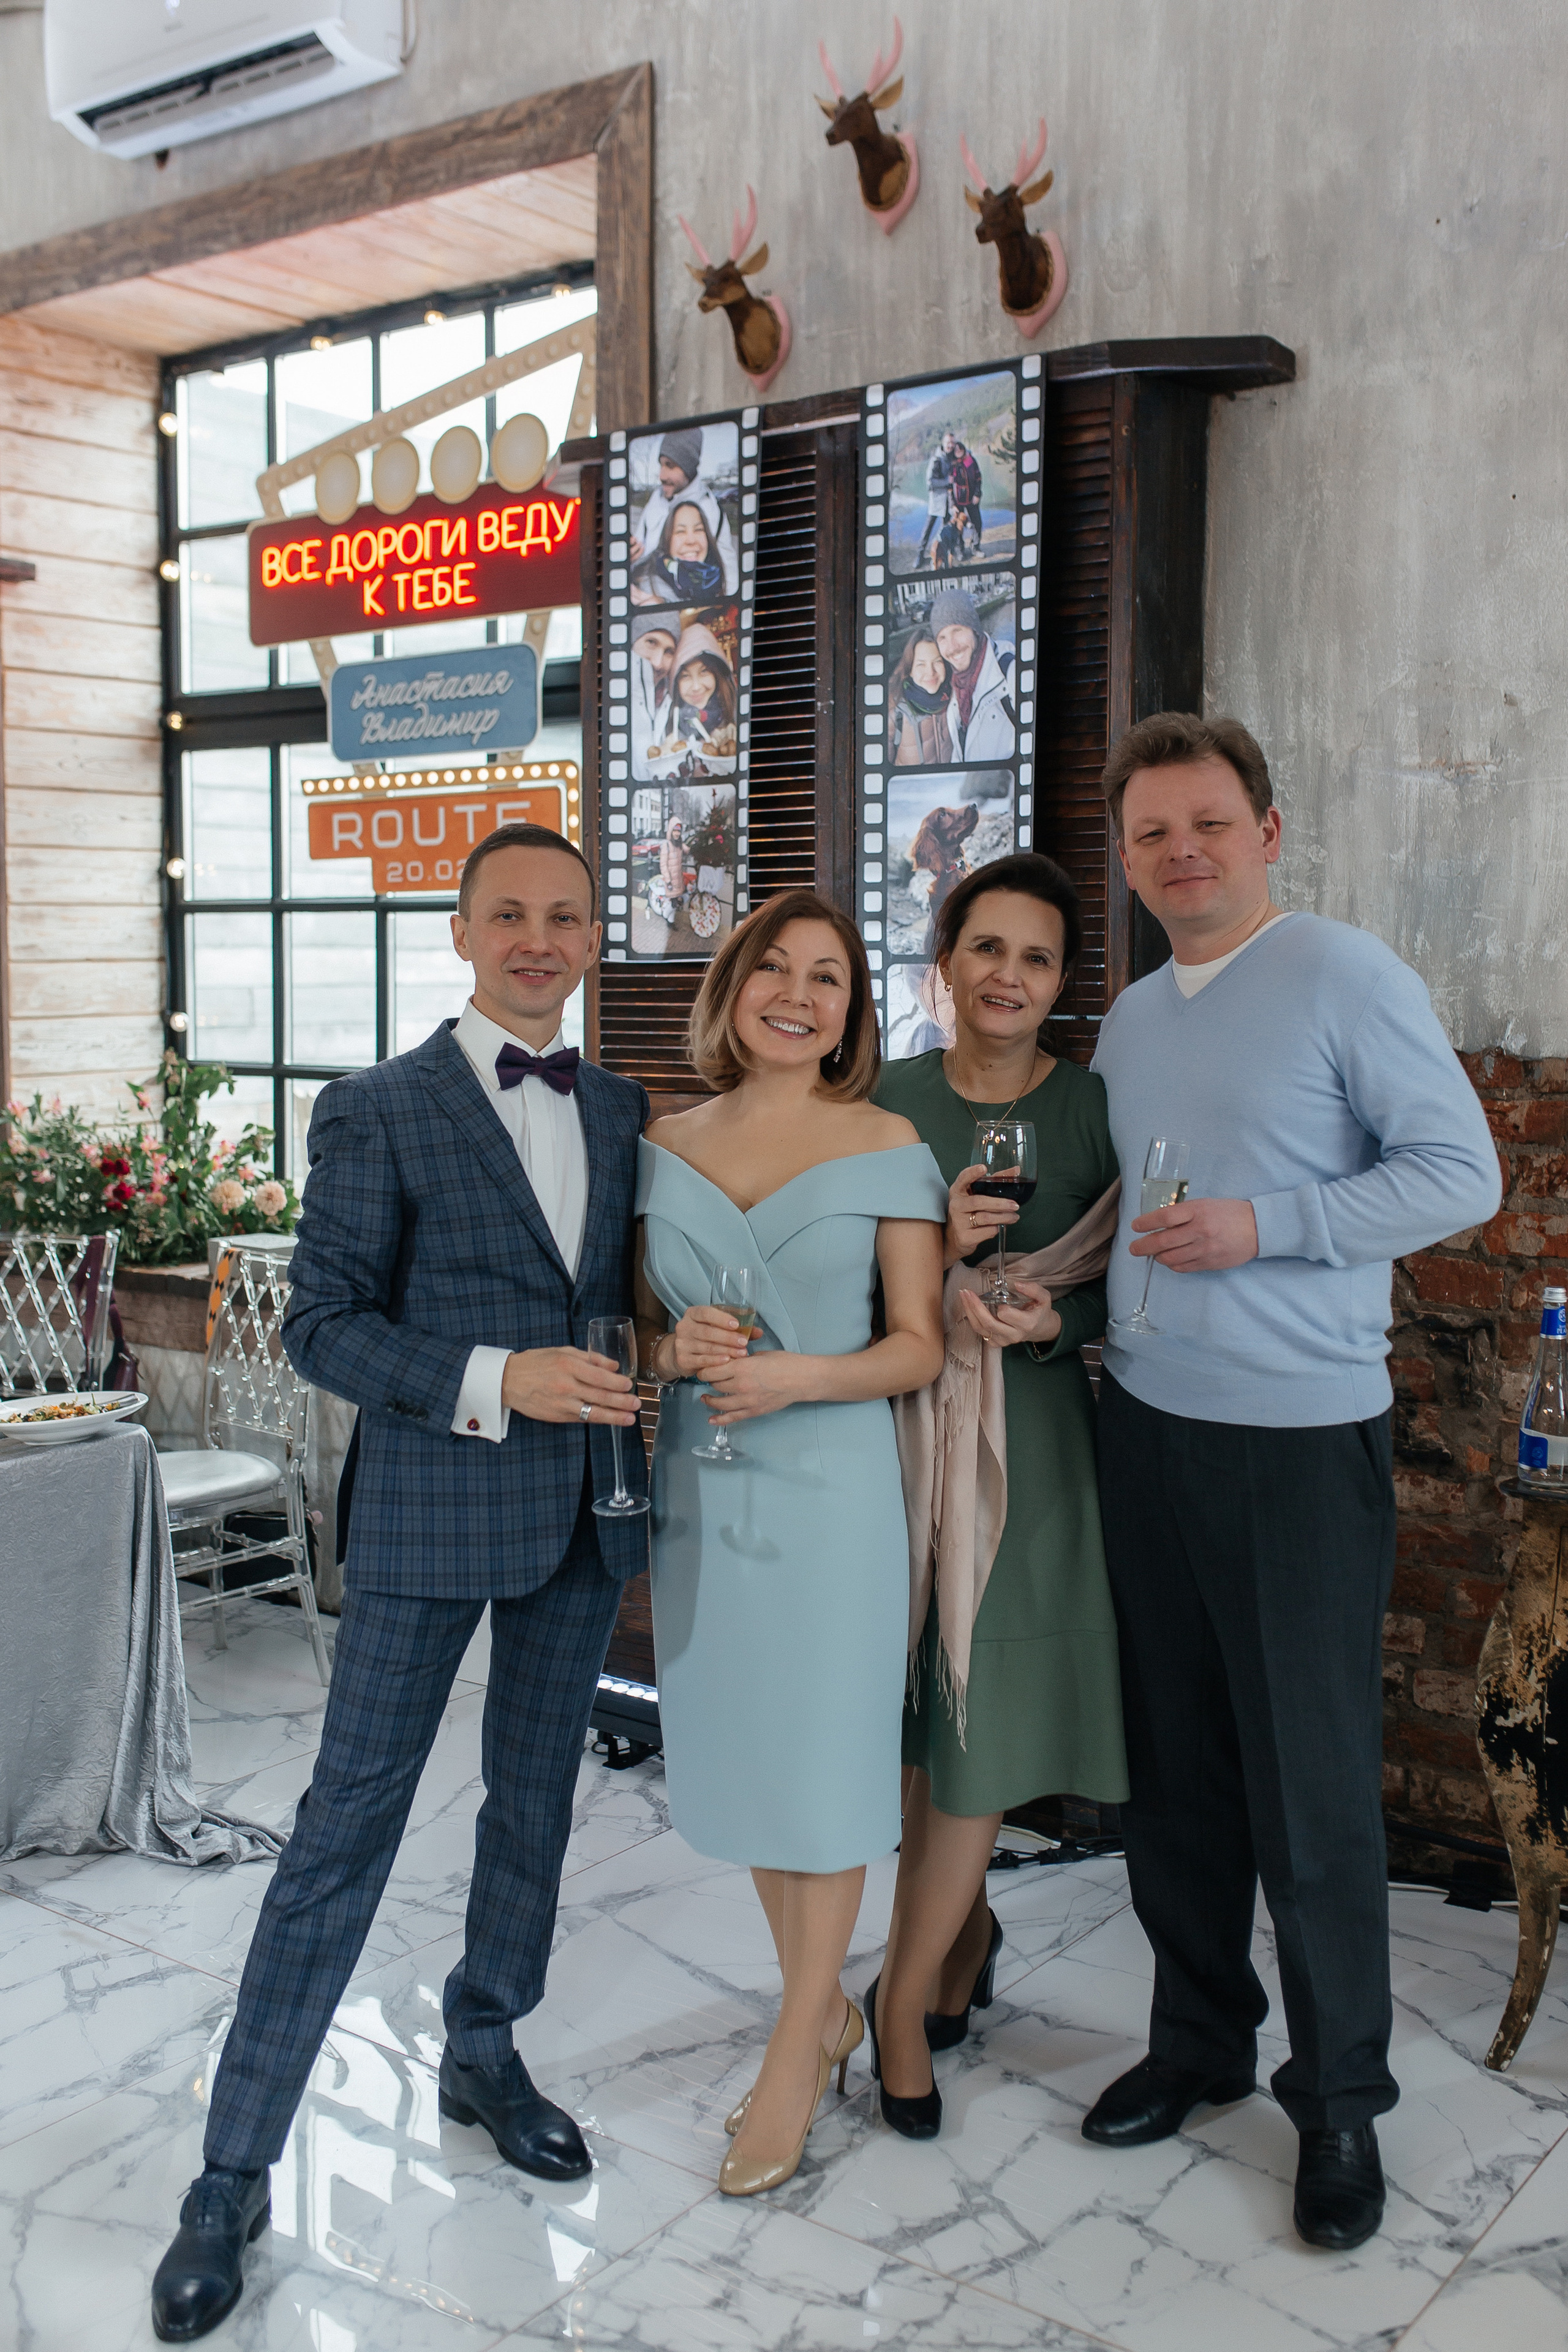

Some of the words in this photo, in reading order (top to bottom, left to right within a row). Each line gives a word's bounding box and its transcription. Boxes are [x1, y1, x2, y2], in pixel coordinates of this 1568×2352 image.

[261, 539, 323, 588] ВСЕ
[325, 518, 468, 586] ДОРОГИ
[477, 499, 581, 557] ВЕДУ
[363, 574, 385, 616] К
[391, 562, 477, 612] ТЕБЕ
[350, 670, 514, 710] Анастасия
[359, 702, 500, 745] Владимир
[331, 801, 531, 851] ROUTE
